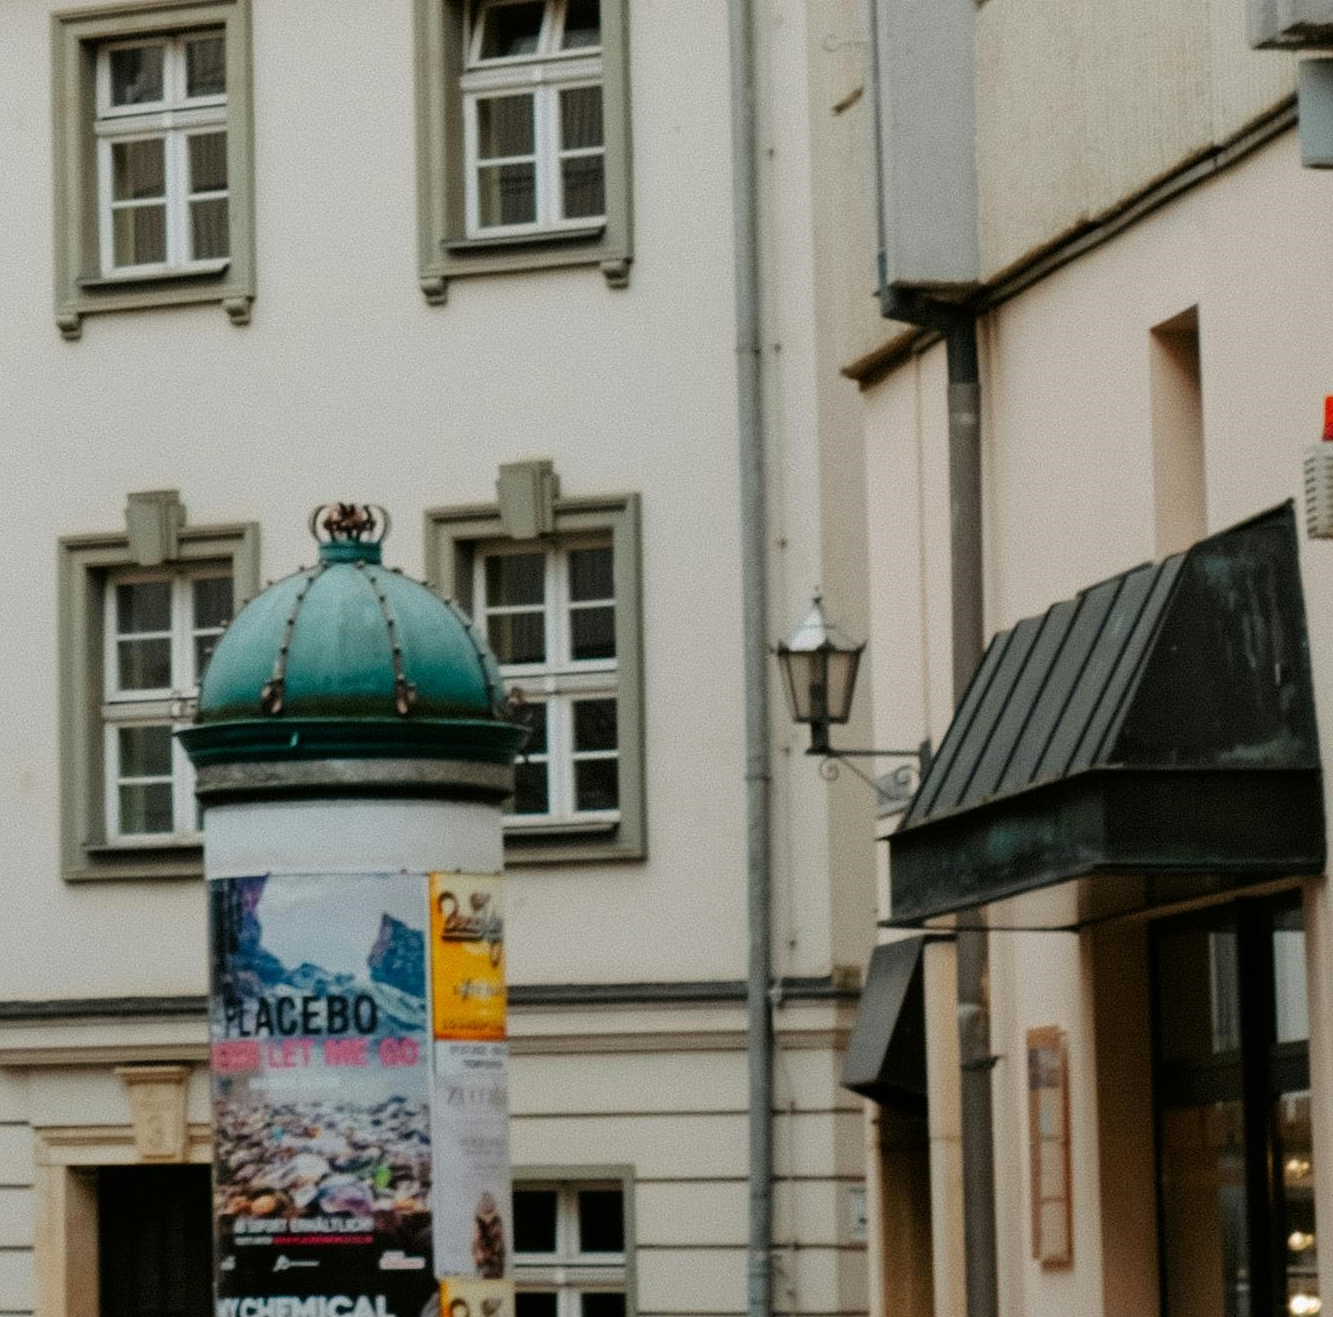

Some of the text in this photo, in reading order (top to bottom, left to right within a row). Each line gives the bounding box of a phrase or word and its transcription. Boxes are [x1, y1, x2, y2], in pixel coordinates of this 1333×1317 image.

[224, 993, 378, 1038] PLACEBO
[267, 1038, 314, 1069] LET
[378, 1036, 420, 1068] GO
[239, 1294, 397, 1317] CHEMICAL
